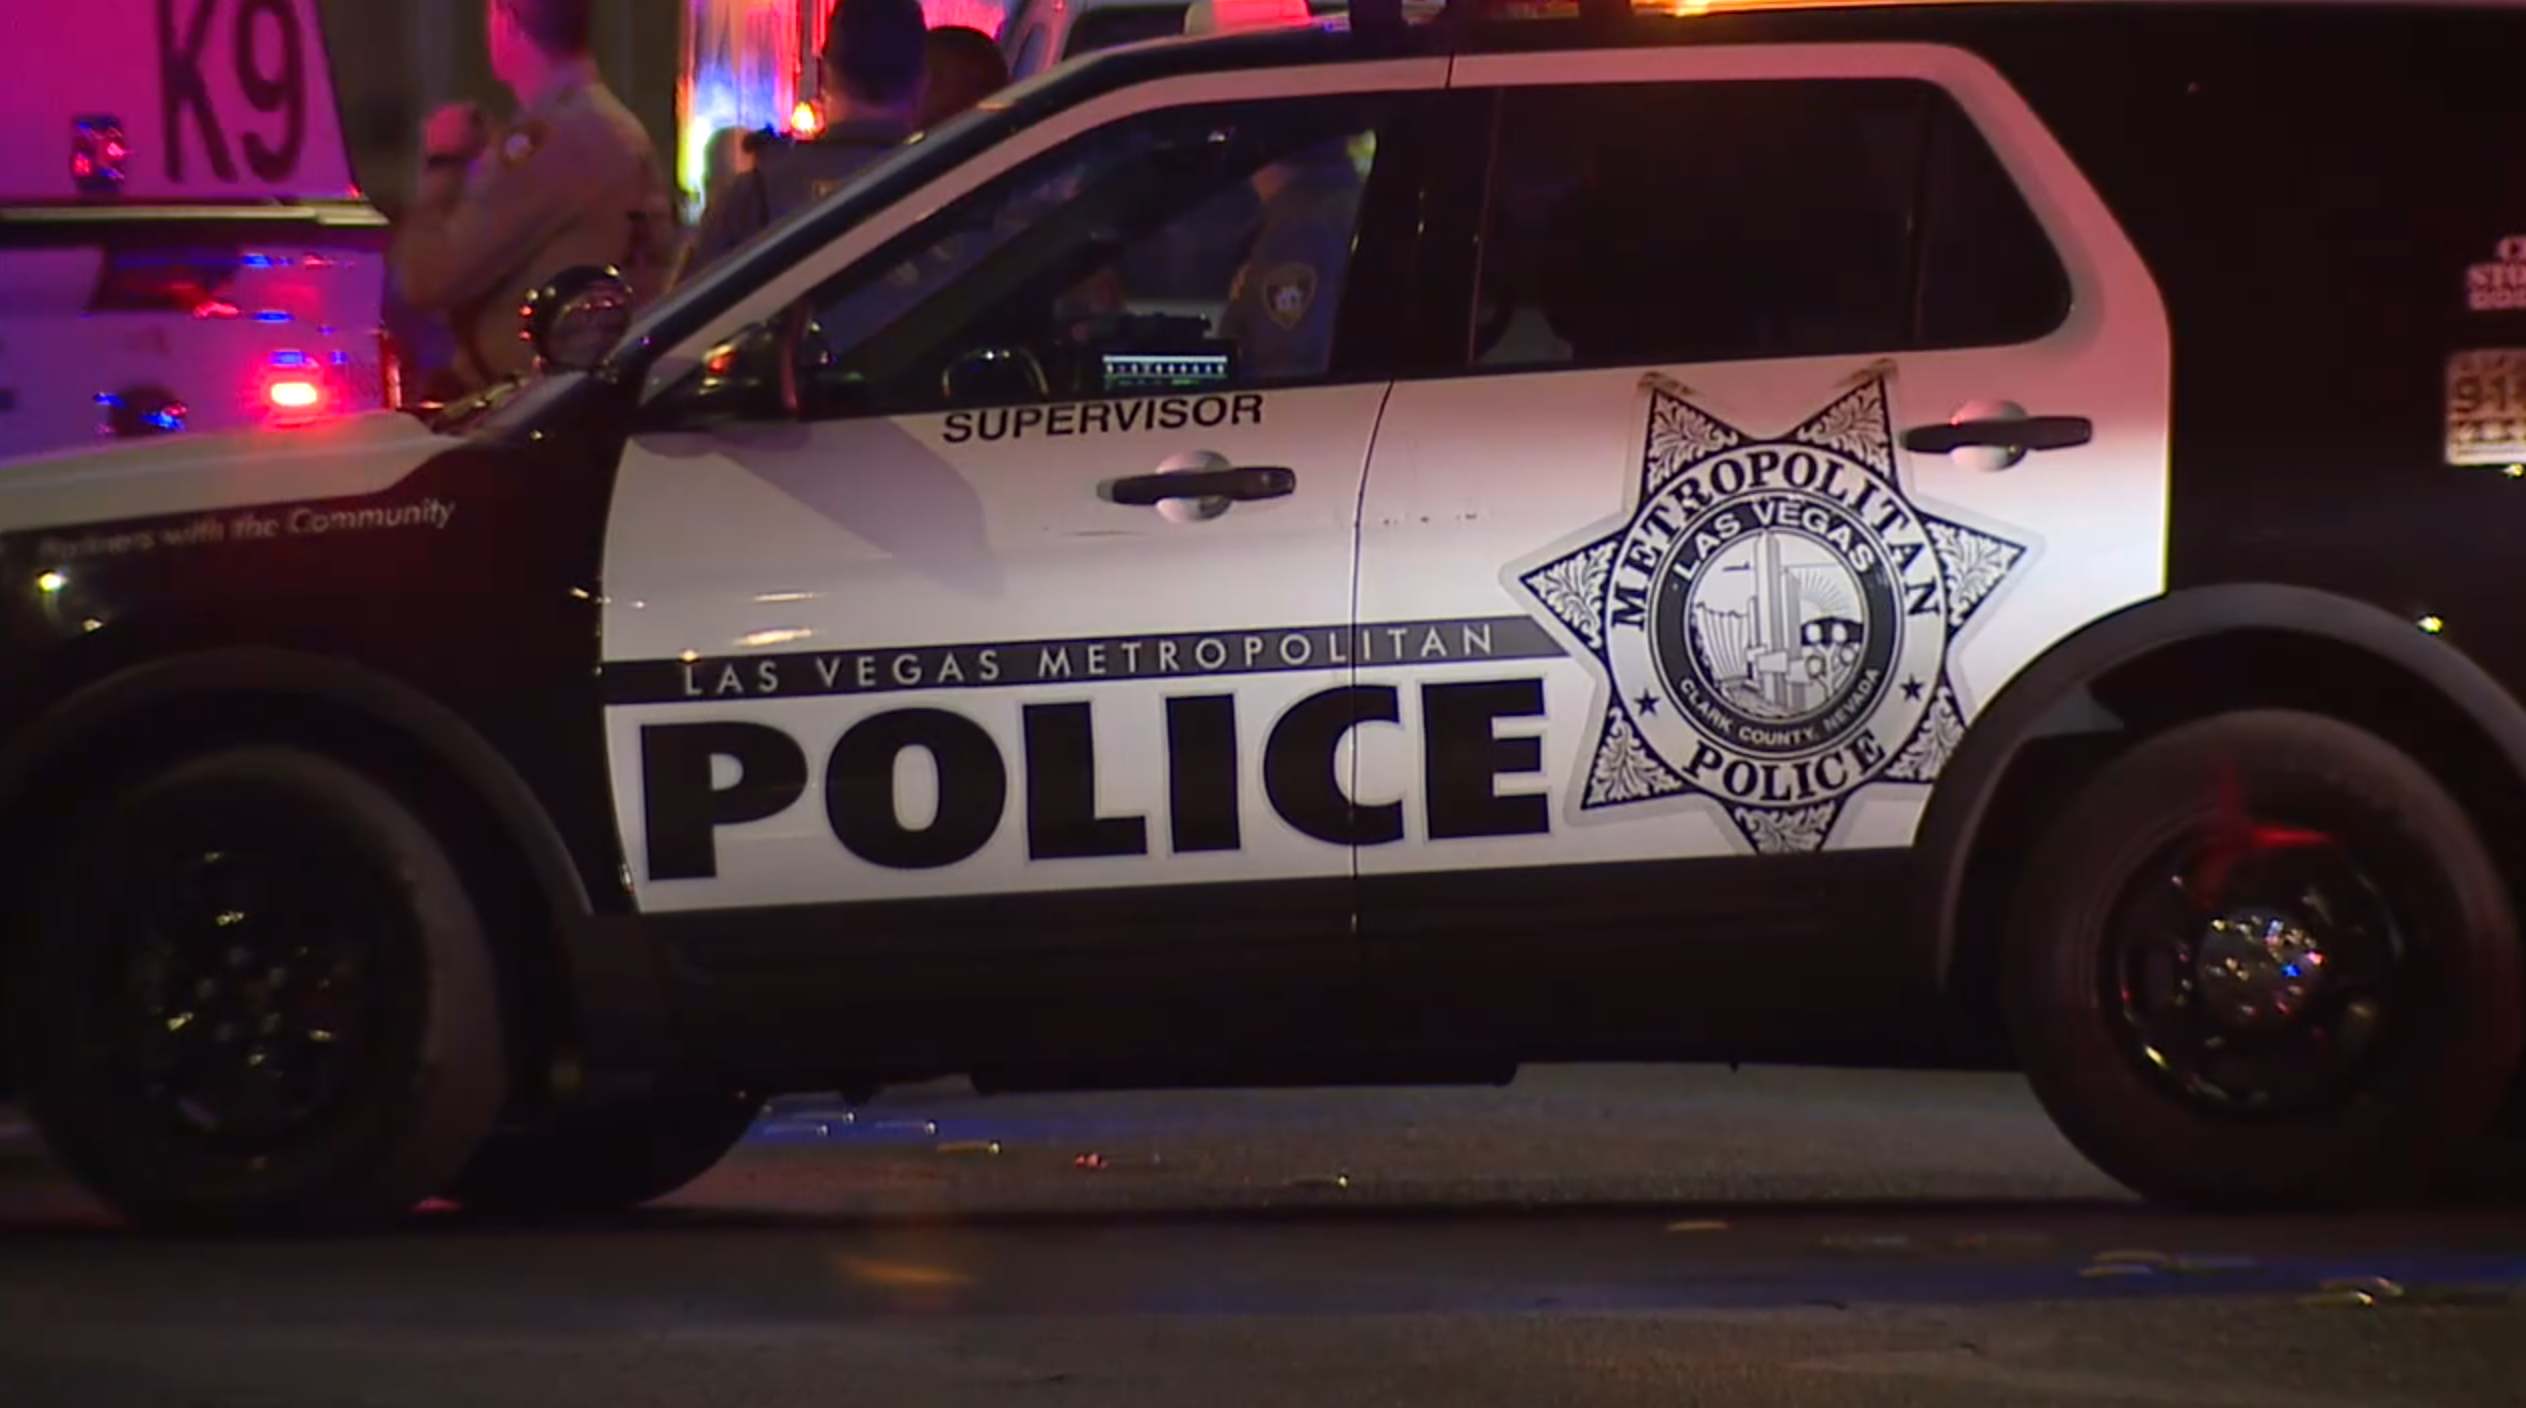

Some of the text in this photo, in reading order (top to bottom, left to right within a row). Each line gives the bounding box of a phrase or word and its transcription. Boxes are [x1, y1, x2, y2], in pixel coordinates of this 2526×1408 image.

[155, 0, 304, 184] K9
[942, 393, 1264, 443] SUPERVISOR
[287, 497, 456, 535] Community
[1611, 450, 1940, 632] METROPOLITAN
[1672, 498, 1876, 582] LAS VEGAS
[684, 622, 1493, 696] LAS VEGAS METROPOLITAN
[1680, 678, 1733, 732] CLARK
[1823, 666, 1881, 732] NEVADA
[639, 677, 1551, 881] POLICE
[1681, 728, 1887, 802] POLICE
